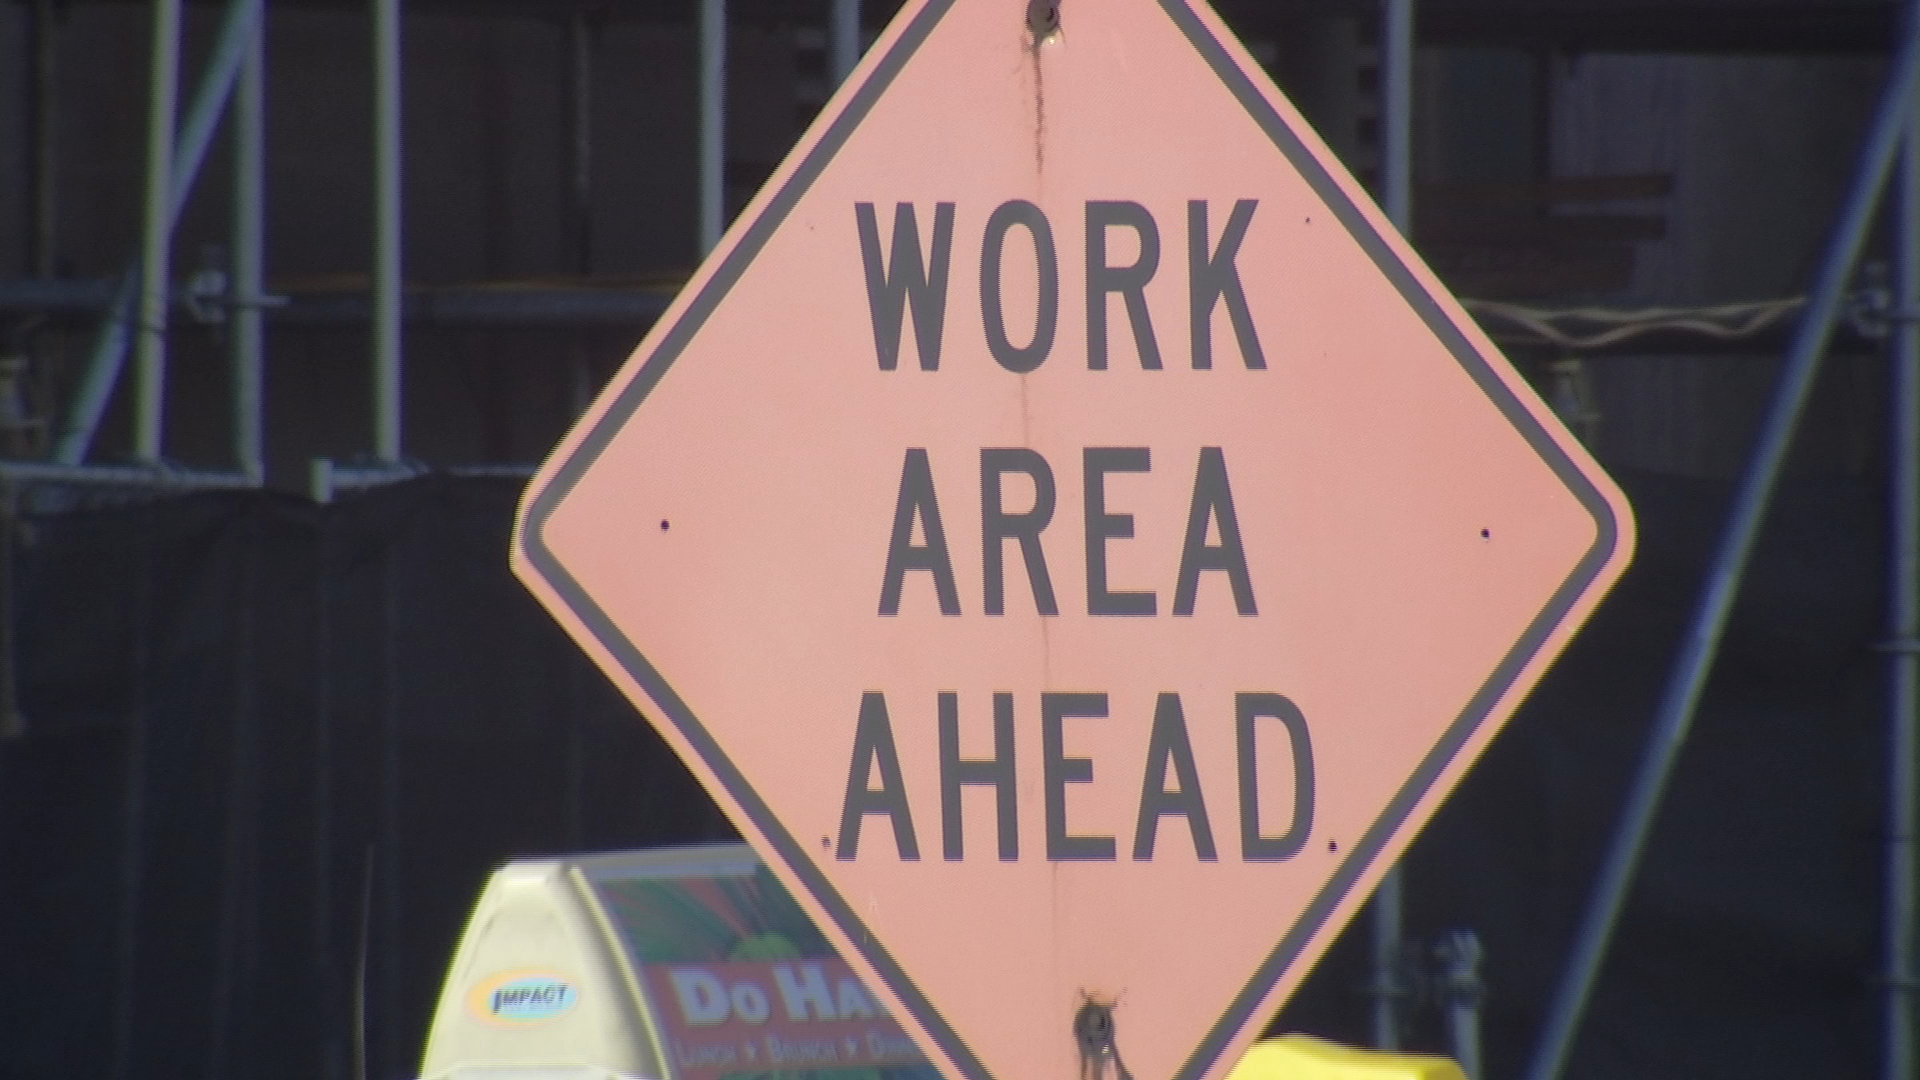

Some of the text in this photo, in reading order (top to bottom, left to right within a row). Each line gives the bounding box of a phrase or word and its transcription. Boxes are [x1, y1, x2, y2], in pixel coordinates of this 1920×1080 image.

[855, 199, 1268, 373] WORK
[878, 446, 1259, 617] AREA
[835, 690, 1315, 862] AHEAD
[491, 983, 568, 1015] IMPACT
